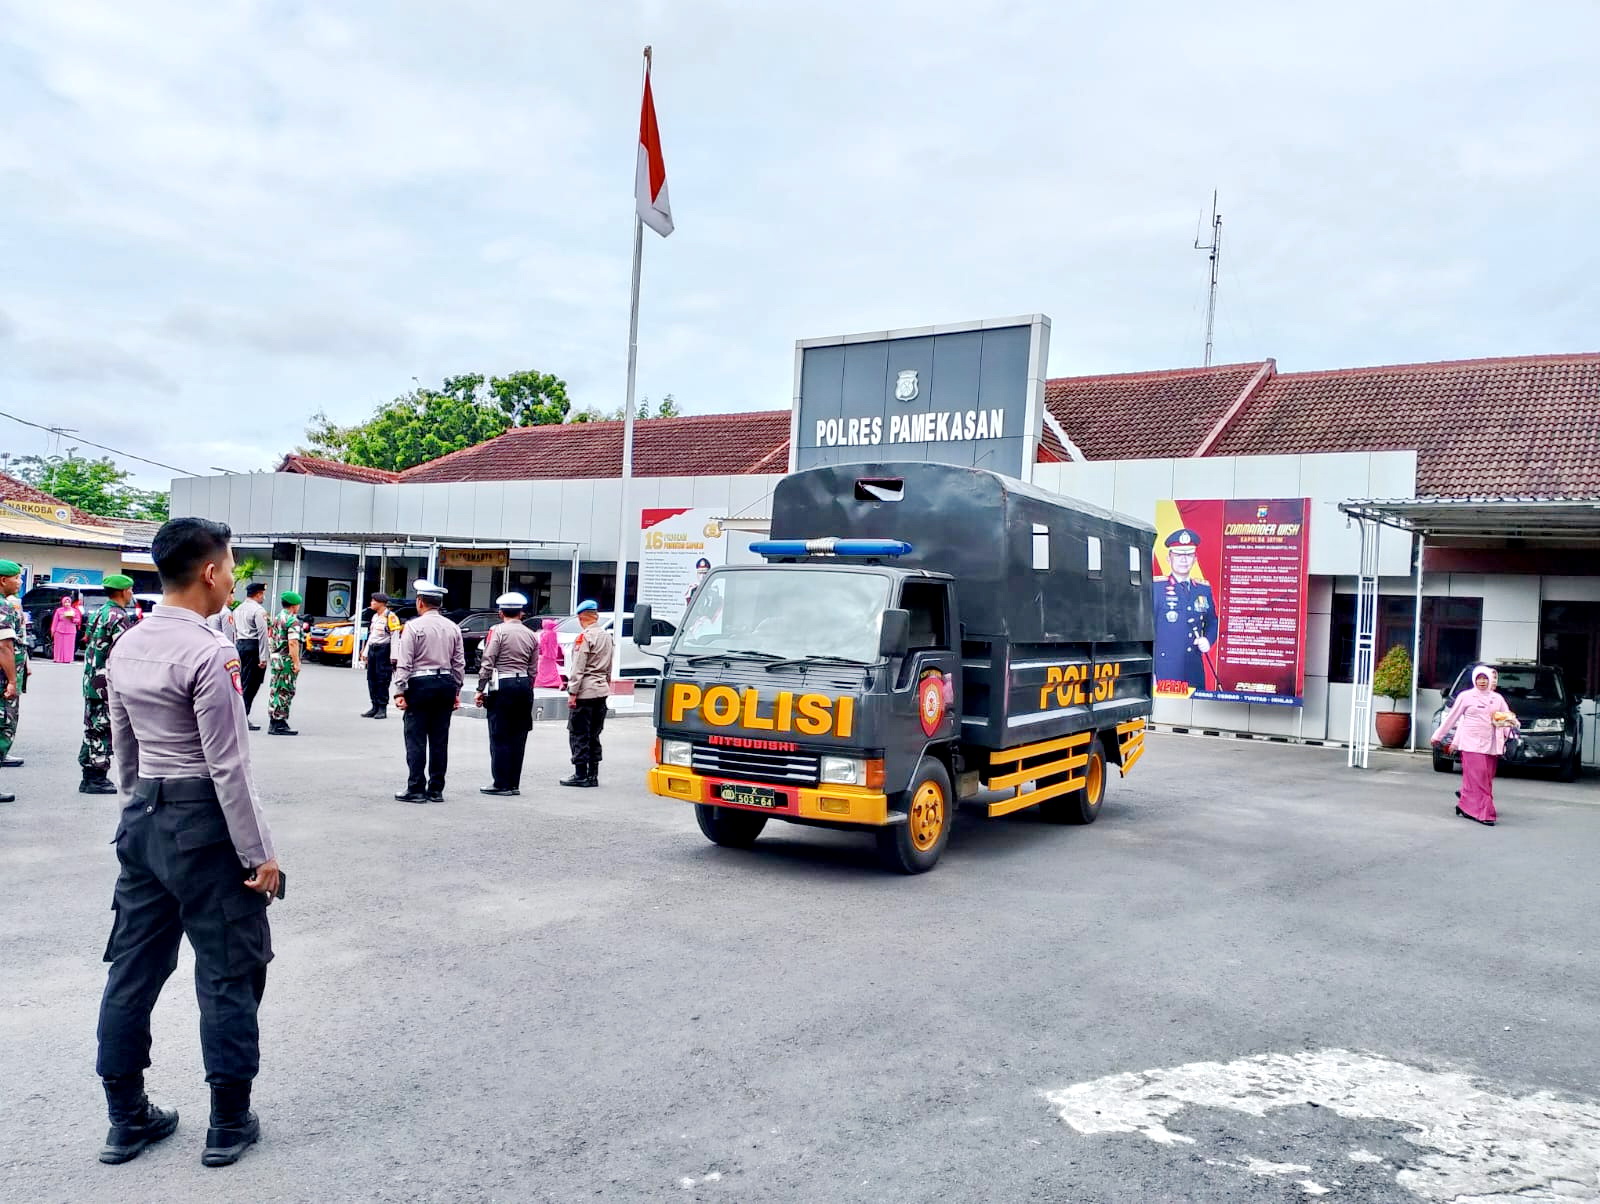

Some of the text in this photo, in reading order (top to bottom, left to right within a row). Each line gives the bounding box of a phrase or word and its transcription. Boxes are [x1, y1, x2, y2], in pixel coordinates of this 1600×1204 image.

[816, 409, 1004, 447] POLRES PAMEKASAN
[645, 532, 663, 549] 16
[1224, 524, 1300, 535] COMMANDER WISH
[1039, 662, 1120, 710] POLISI
[670, 683, 854, 737] POLISI
[708, 735, 797, 752] MITSUBISHI
